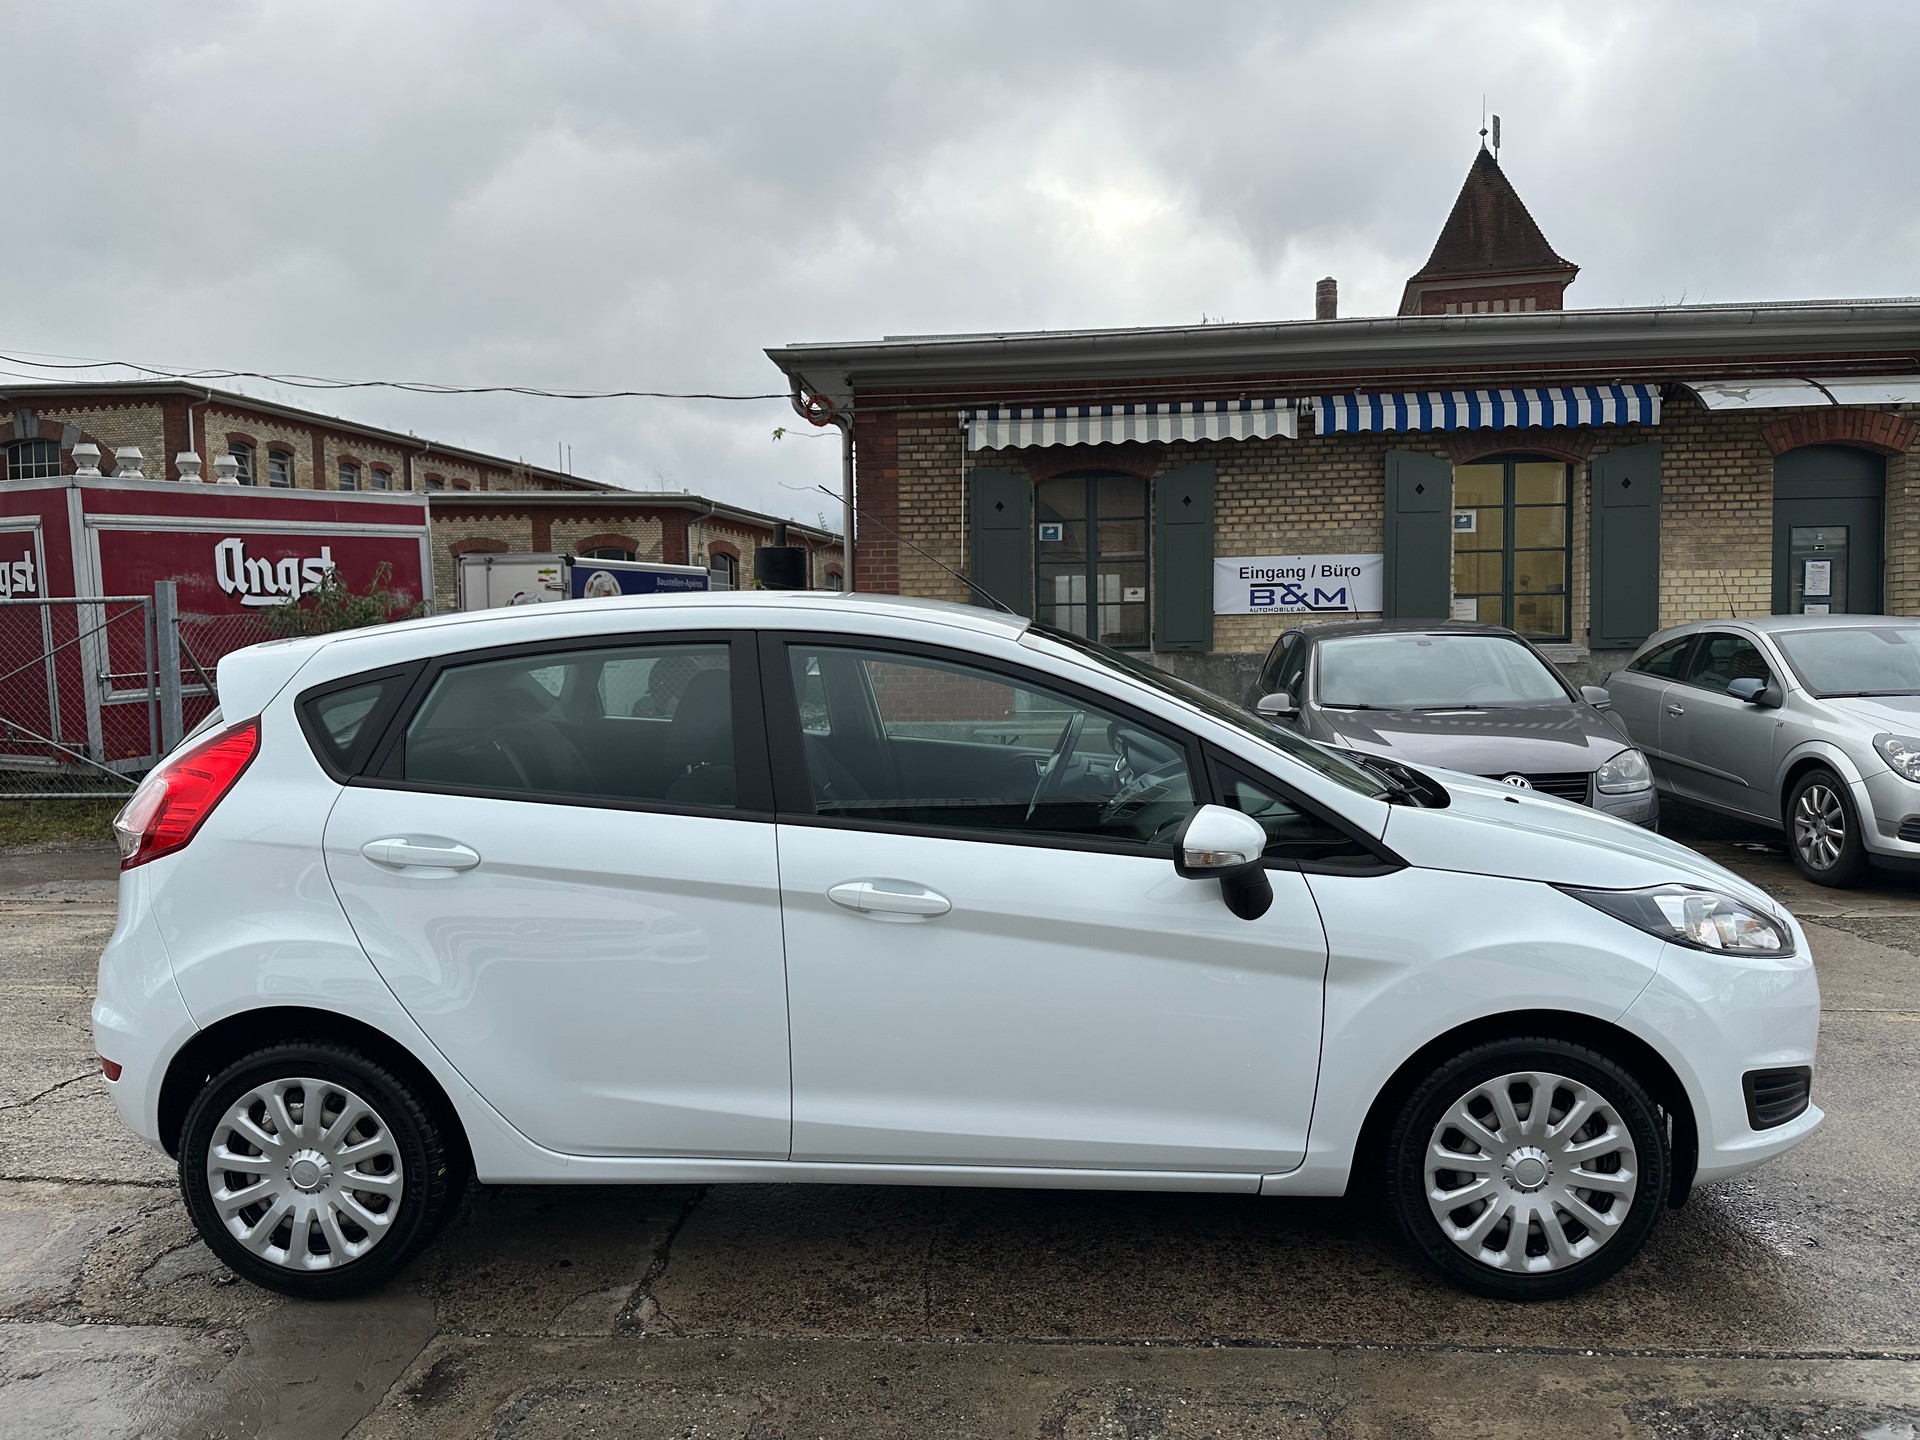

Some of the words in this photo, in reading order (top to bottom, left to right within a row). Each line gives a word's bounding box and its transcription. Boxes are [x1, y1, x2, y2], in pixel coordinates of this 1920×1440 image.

[215, 537, 337, 606] Angst
[1239, 566, 1306, 581] Eingang
[1311, 564, 1316, 578] /
[1321, 564, 1361, 578] Büro
[1250, 583, 1347, 607] B&M
